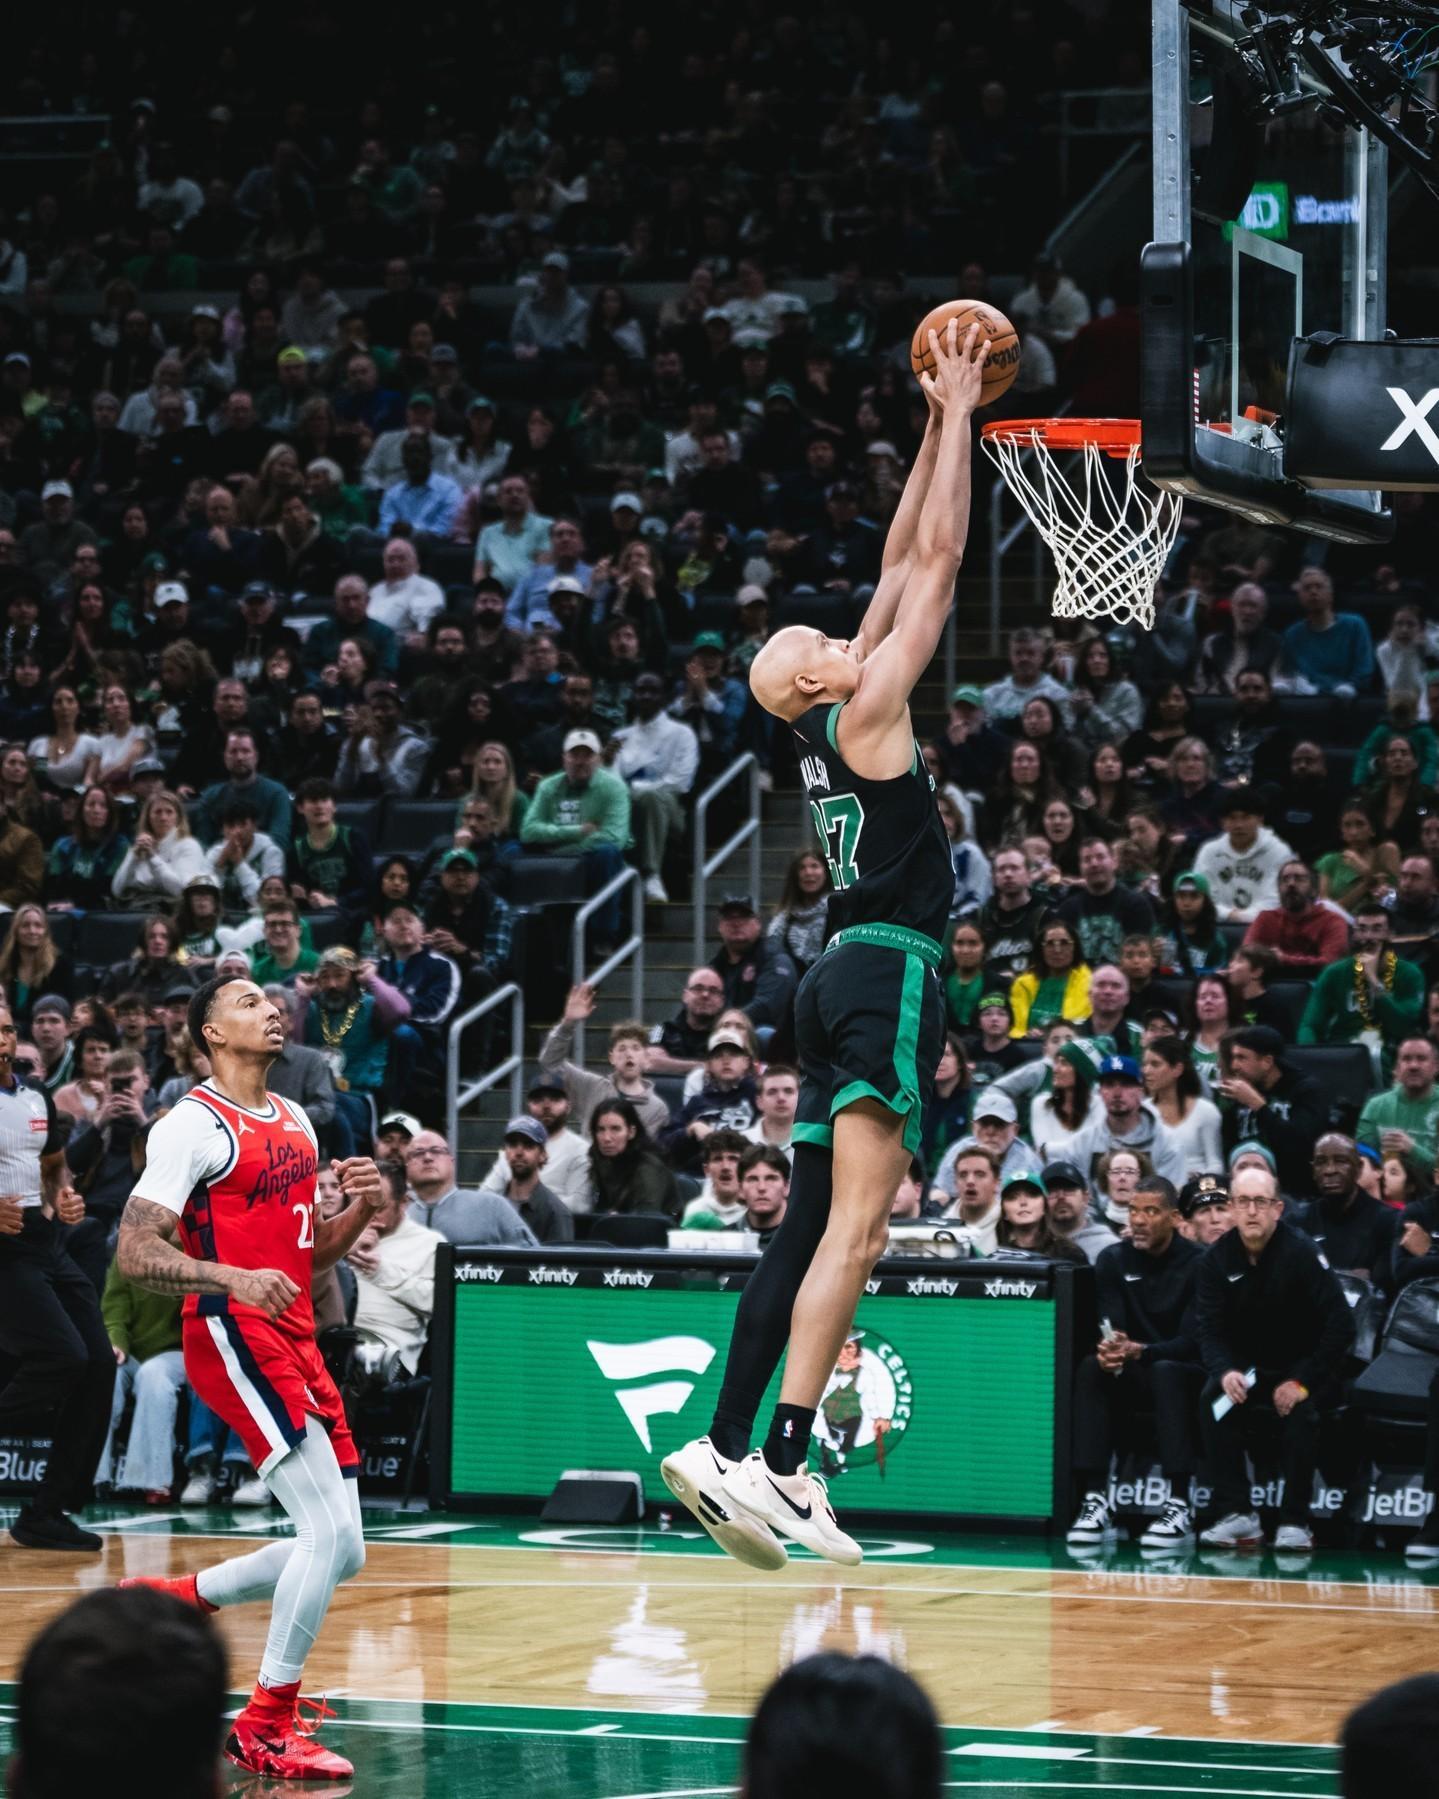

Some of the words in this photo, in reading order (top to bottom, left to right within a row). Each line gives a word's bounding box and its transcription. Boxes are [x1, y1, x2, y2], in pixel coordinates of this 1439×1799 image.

[266, 1138, 298, 1172] Los
[454, 1263, 504, 1284] xfinity
[528, 1264, 579, 1286] xfinity
[603, 1267, 654, 1288] xfinity
[906, 1275, 959, 1296] xfinity
[984, 1277, 1037, 1298] xfinity
[877, 1343, 912, 1431] CELTICS
